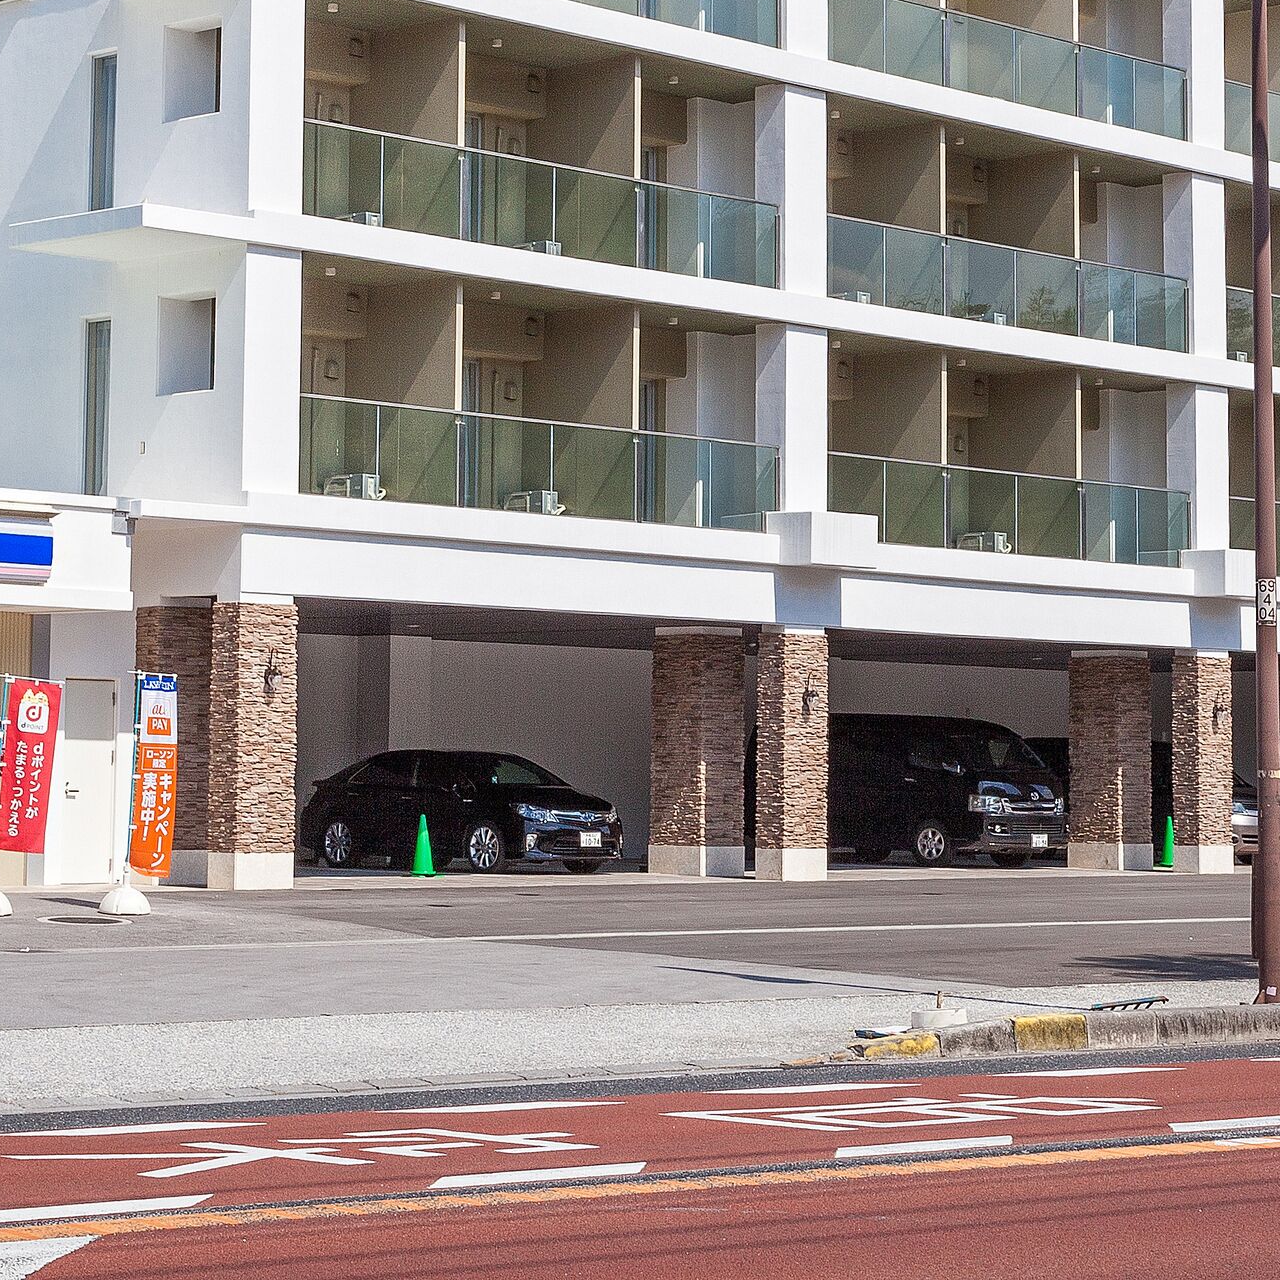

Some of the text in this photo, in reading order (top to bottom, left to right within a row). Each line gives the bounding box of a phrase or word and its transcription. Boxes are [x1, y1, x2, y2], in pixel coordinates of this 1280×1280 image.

[1259, 580, 1274, 592] 69
[1263, 594, 1271, 606] 4
[1260, 607, 1274, 620] 04
[151, 719, 168, 730] PAY
[146, 750, 174, 759] ローソン
[25, 742, 45, 819] dポイントが
[140, 773, 157, 841] 実施中!
[150, 773, 172, 868] キャンペーン
